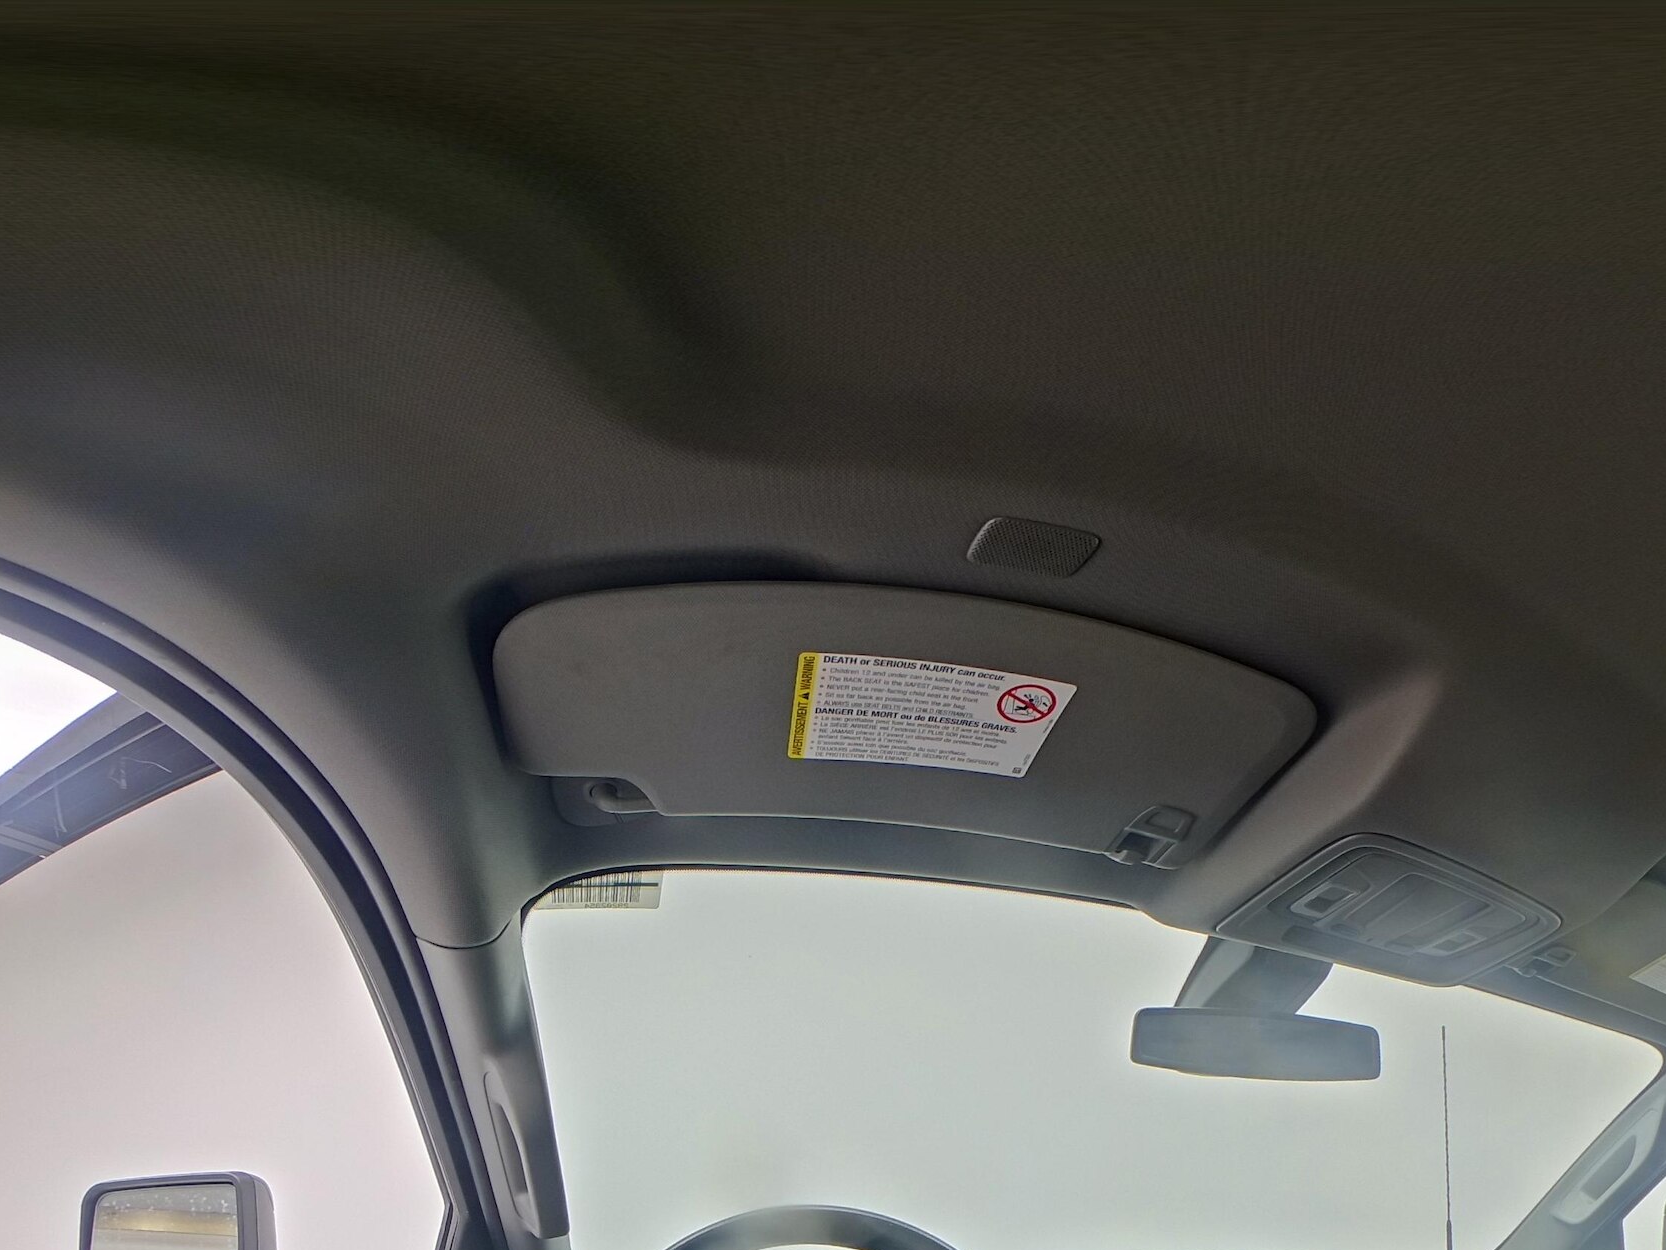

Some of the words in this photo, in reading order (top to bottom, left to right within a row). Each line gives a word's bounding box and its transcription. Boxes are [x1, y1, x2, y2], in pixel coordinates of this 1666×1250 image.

[800, 655, 815, 690] WARNING
[823, 655, 858, 665] DEATH
[873, 659, 917, 670] SERIOUS
[919, 662, 956, 674] INJURY
[957, 669, 975, 677] can
[978, 671, 1006, 681] occur.
[792, 702, 808, 756] AVERTISSEMENT
[815, 707, 853, 715] DANGER
[871, 710, 899, 719] MORT
[928, 715, 980, 728] BLESSURES
[981, 722, 1018, 733] GRAVES.
